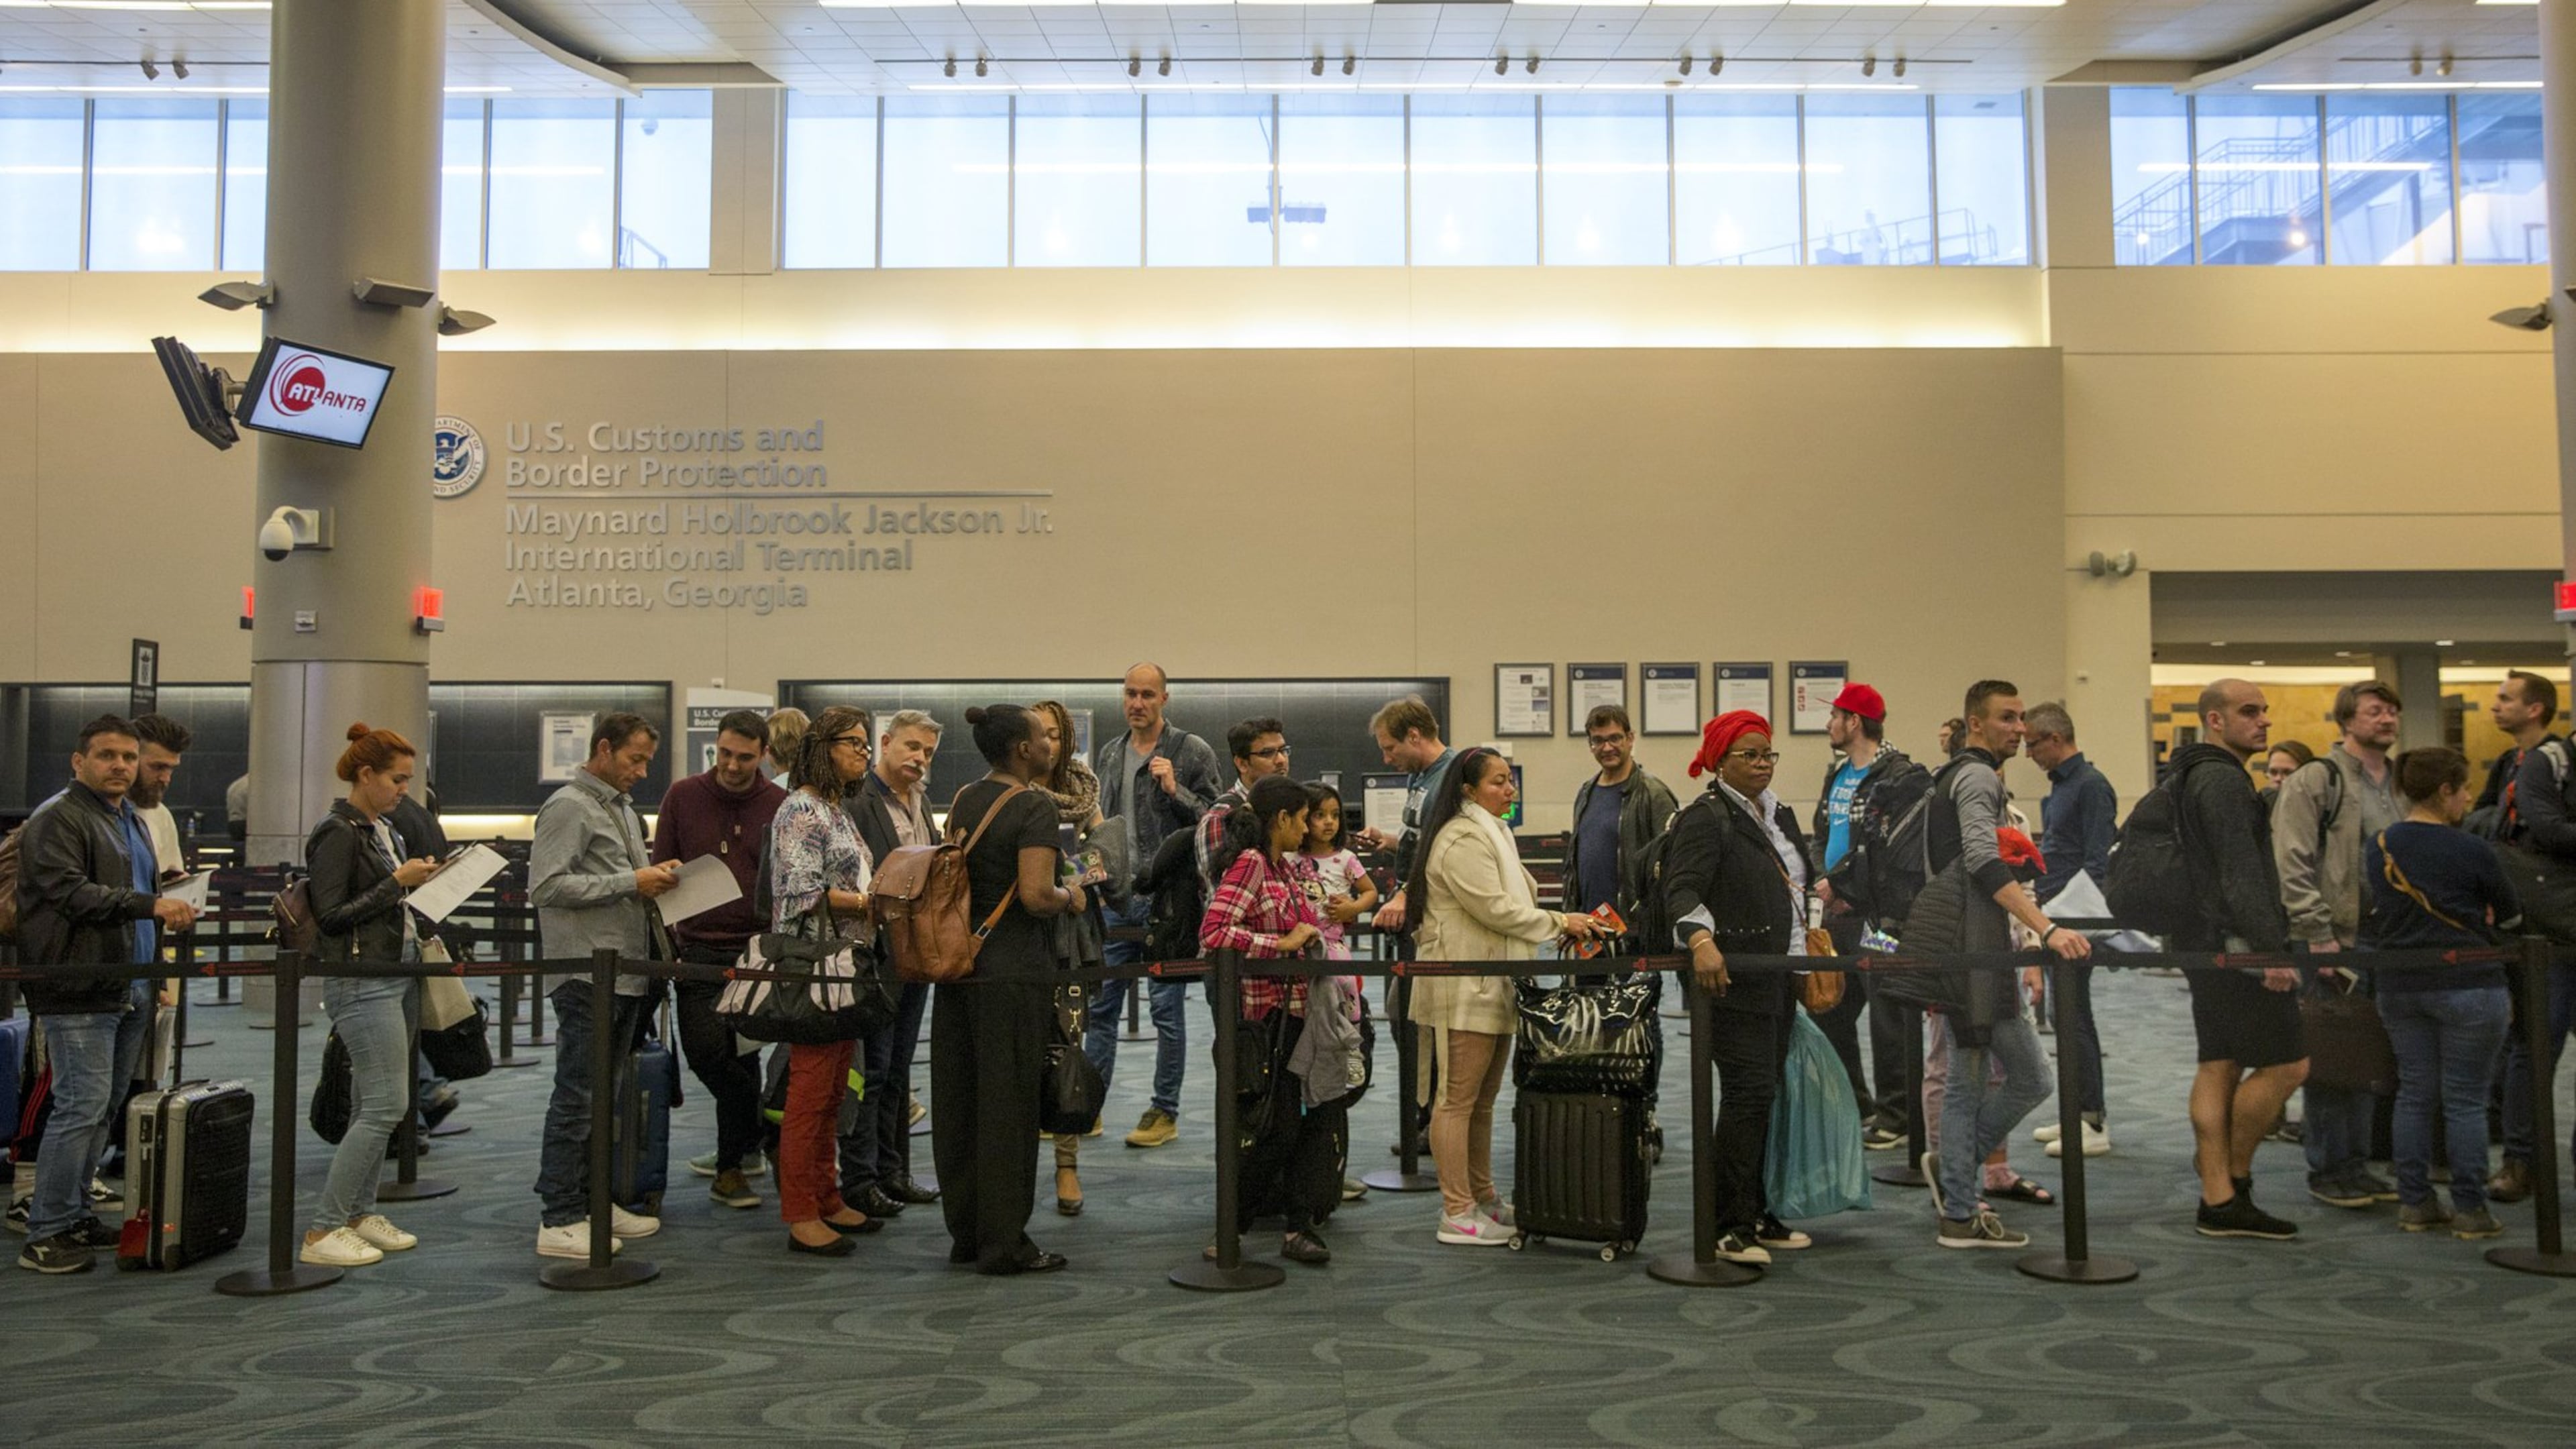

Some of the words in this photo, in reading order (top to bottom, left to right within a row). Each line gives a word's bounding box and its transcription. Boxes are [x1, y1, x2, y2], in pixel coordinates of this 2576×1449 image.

[288, 382, 366, 412] ATLANTA
[506, 421, 575, 452] U.S.
[588, 421, 745, 452] Customs
[756, 419, 824, 451] and
[449, 461, 481, 492] SECURITY
[506, 455, 629, 488] Border
[639, 456, 827, 488] Protection
[506, 503, 668, 543] Maynard
[682, 502, 853, 535] Holbrook
[863, 502, 1004, 534] Jackson
[1016, 502, 1053, 534] Jr.
[505, 539, 744, 571] International
[756, 538, 912, 571] Terminal
[506, 575, 654, 611] Atlanta,
[663, 576, 808, 616] Georgia
[693, 709, 710, 718] U.S.
[694, 718, 720, 727] Borde
